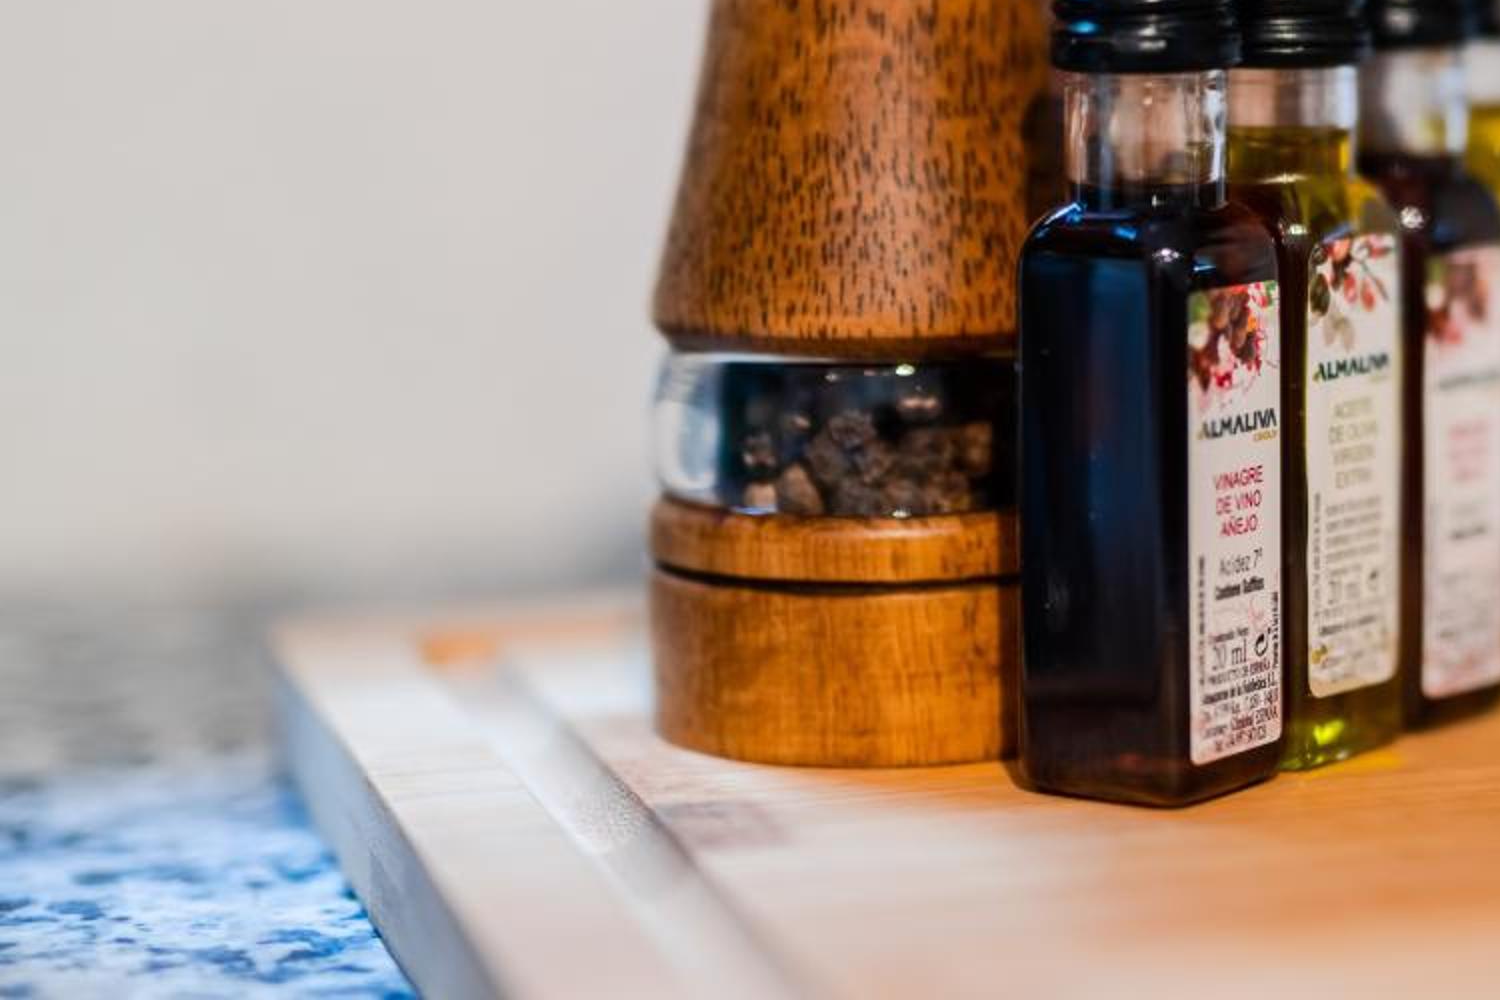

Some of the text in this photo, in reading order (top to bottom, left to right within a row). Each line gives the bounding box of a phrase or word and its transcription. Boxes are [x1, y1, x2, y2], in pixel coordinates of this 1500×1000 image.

[1312, 353, 1388, 382] ALMALIVA
[1197, 408, 1277, 440] ALMALIVA
[1214, 464, 1263, 490] VINAGRE
[1215, 488, 1262, 516] DE VINO
[1220, 514, 1258, 537] AÑEJO
[1219, 554, 1251, 576] Acidez
[1231, 637, 1247, 665] ml
